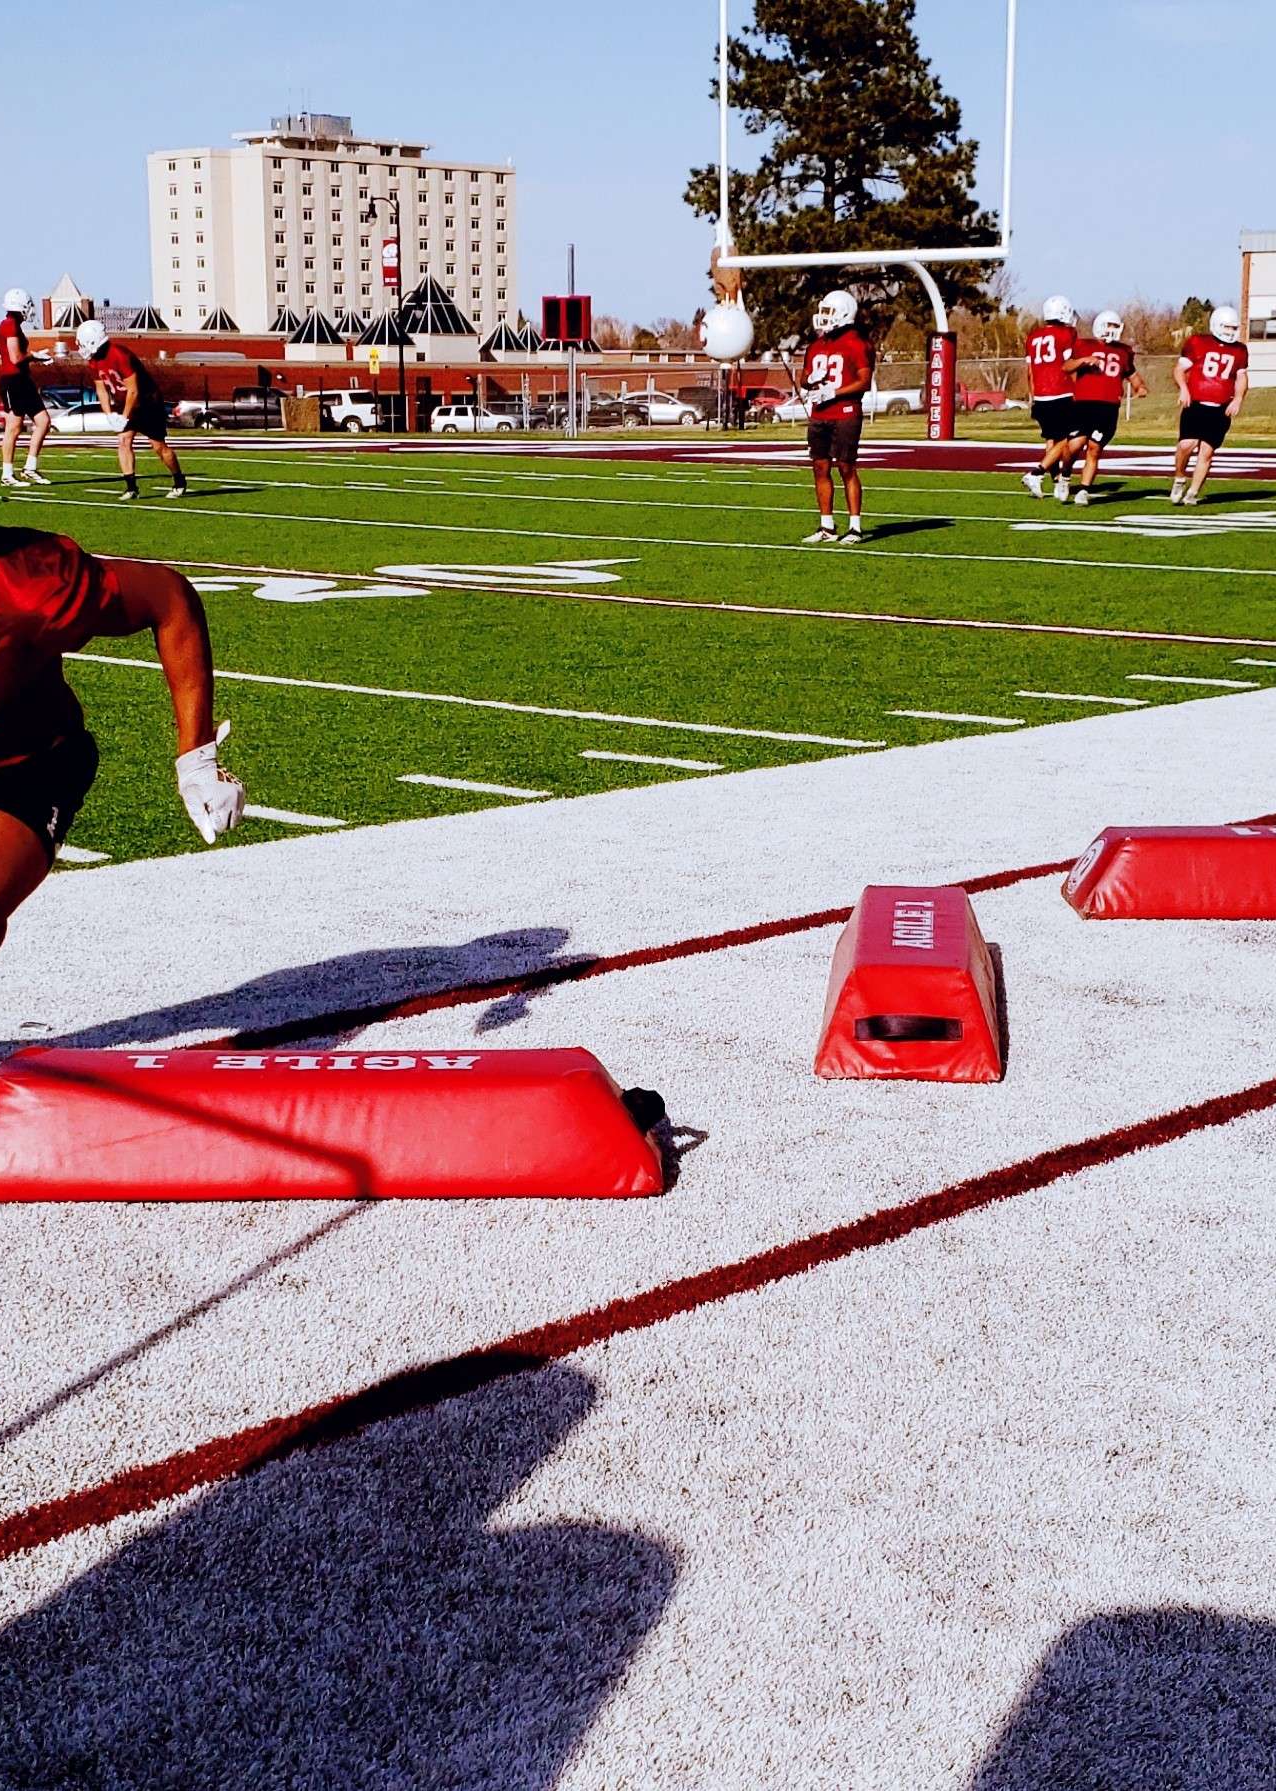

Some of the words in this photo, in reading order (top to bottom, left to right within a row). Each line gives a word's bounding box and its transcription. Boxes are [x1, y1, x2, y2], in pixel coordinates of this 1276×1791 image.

[1036, 335, 1056, 364] 73
[1202, 351, 1235, 379] 67
[930, 335, 943, 439] EAGLES
[894, 900, 935, 908] 1
[891, 909, 934, 950] AGILE
[127, 1055, 170, 1070] 1
[212, 1055, 482, 1071] AGILE
